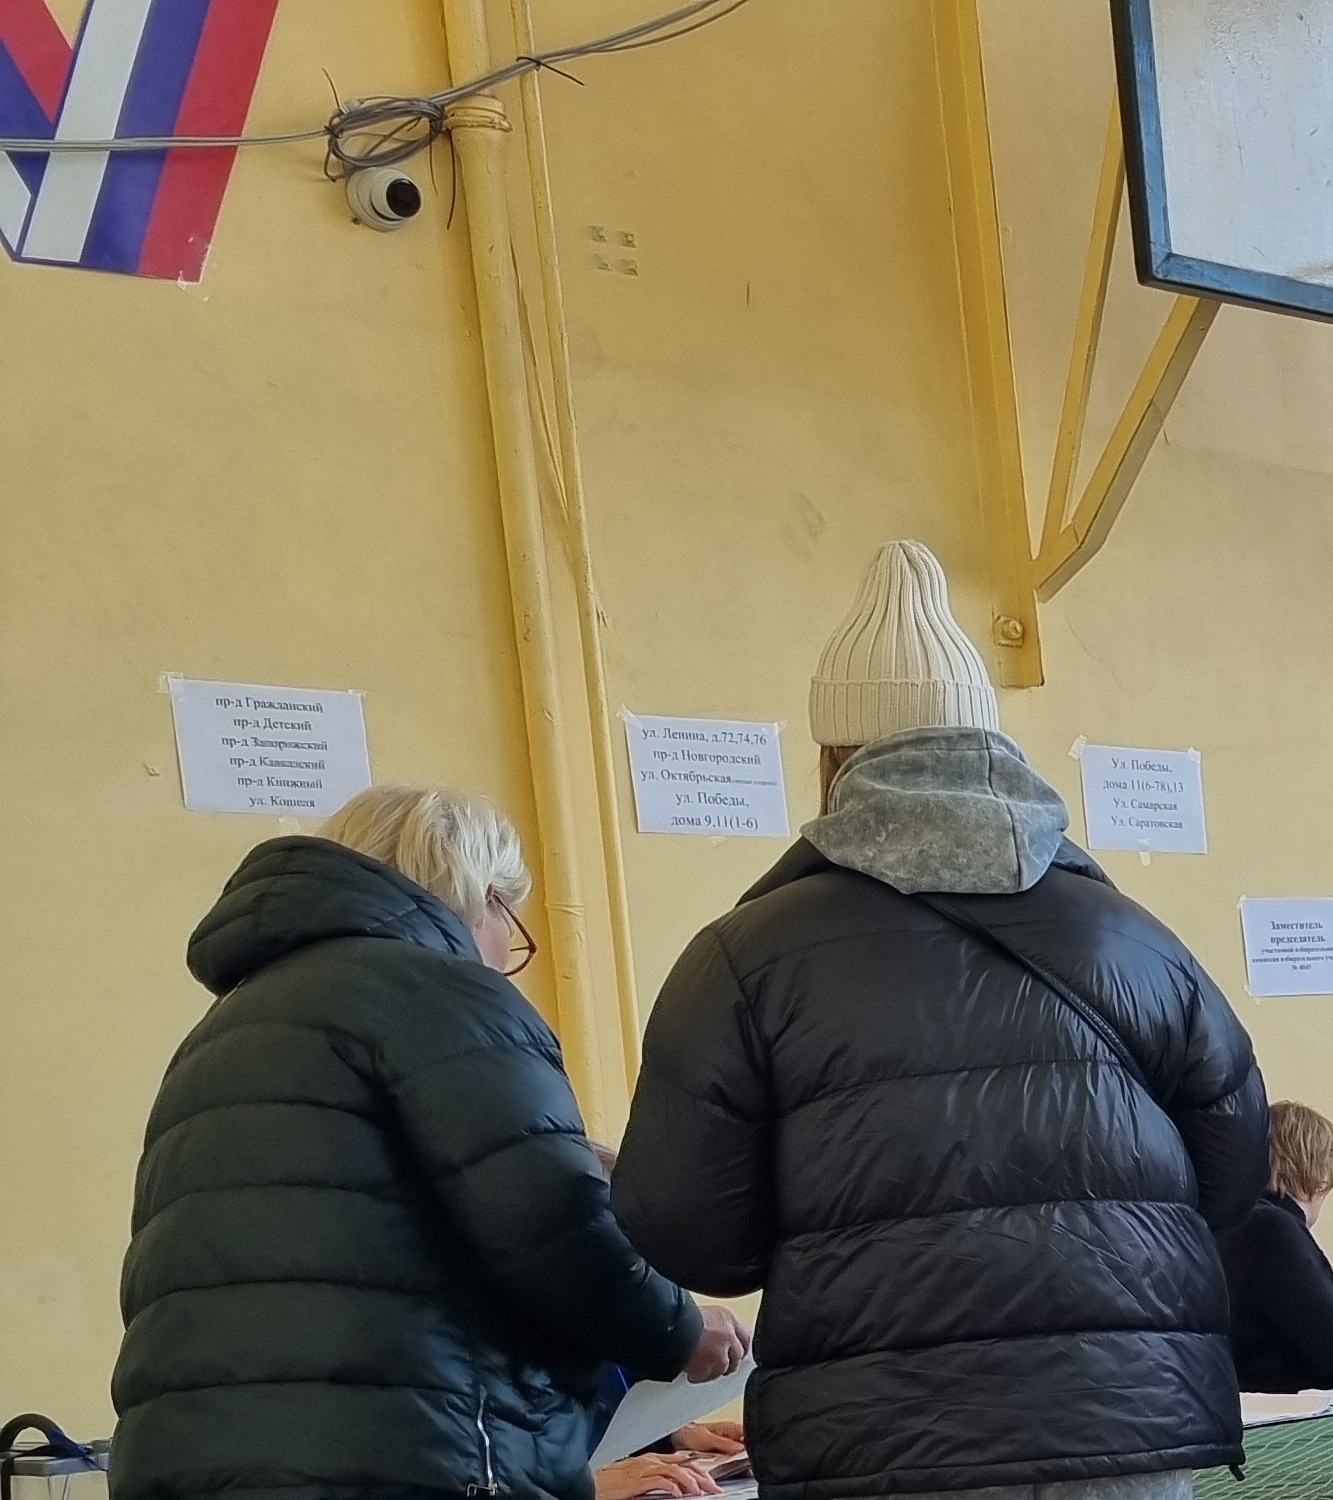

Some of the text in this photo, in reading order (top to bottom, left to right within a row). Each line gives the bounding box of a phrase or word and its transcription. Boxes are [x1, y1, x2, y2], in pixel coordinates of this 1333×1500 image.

[215, 697, 323, 713] пр-д Гражданский
[234, 717, 312, 731] пр-д Детский
[222, 736, 249, 748] пр-д
[642, 728, 767, 746] ул. Ленина, д.72,74,76
[230, 756, 256, 768] пр-д
[654, 750, 762, 765] пр-д Новгородский
[640, 770, 658, 781] ул.
[237, 776, 263, 788] пр-д
[1103, 780, 1128, 790] дома
[249, 796, 316, 808] ул. Кошеля
[676, 792, 750, 808] ул. Победы,
[1130, 799, 1178, 812] Самарская
[671, 816, 701, 827] дома
[1128, 817, 1183, 829] Саратовская
[1270, 921, 1323, 930] Заместитель
